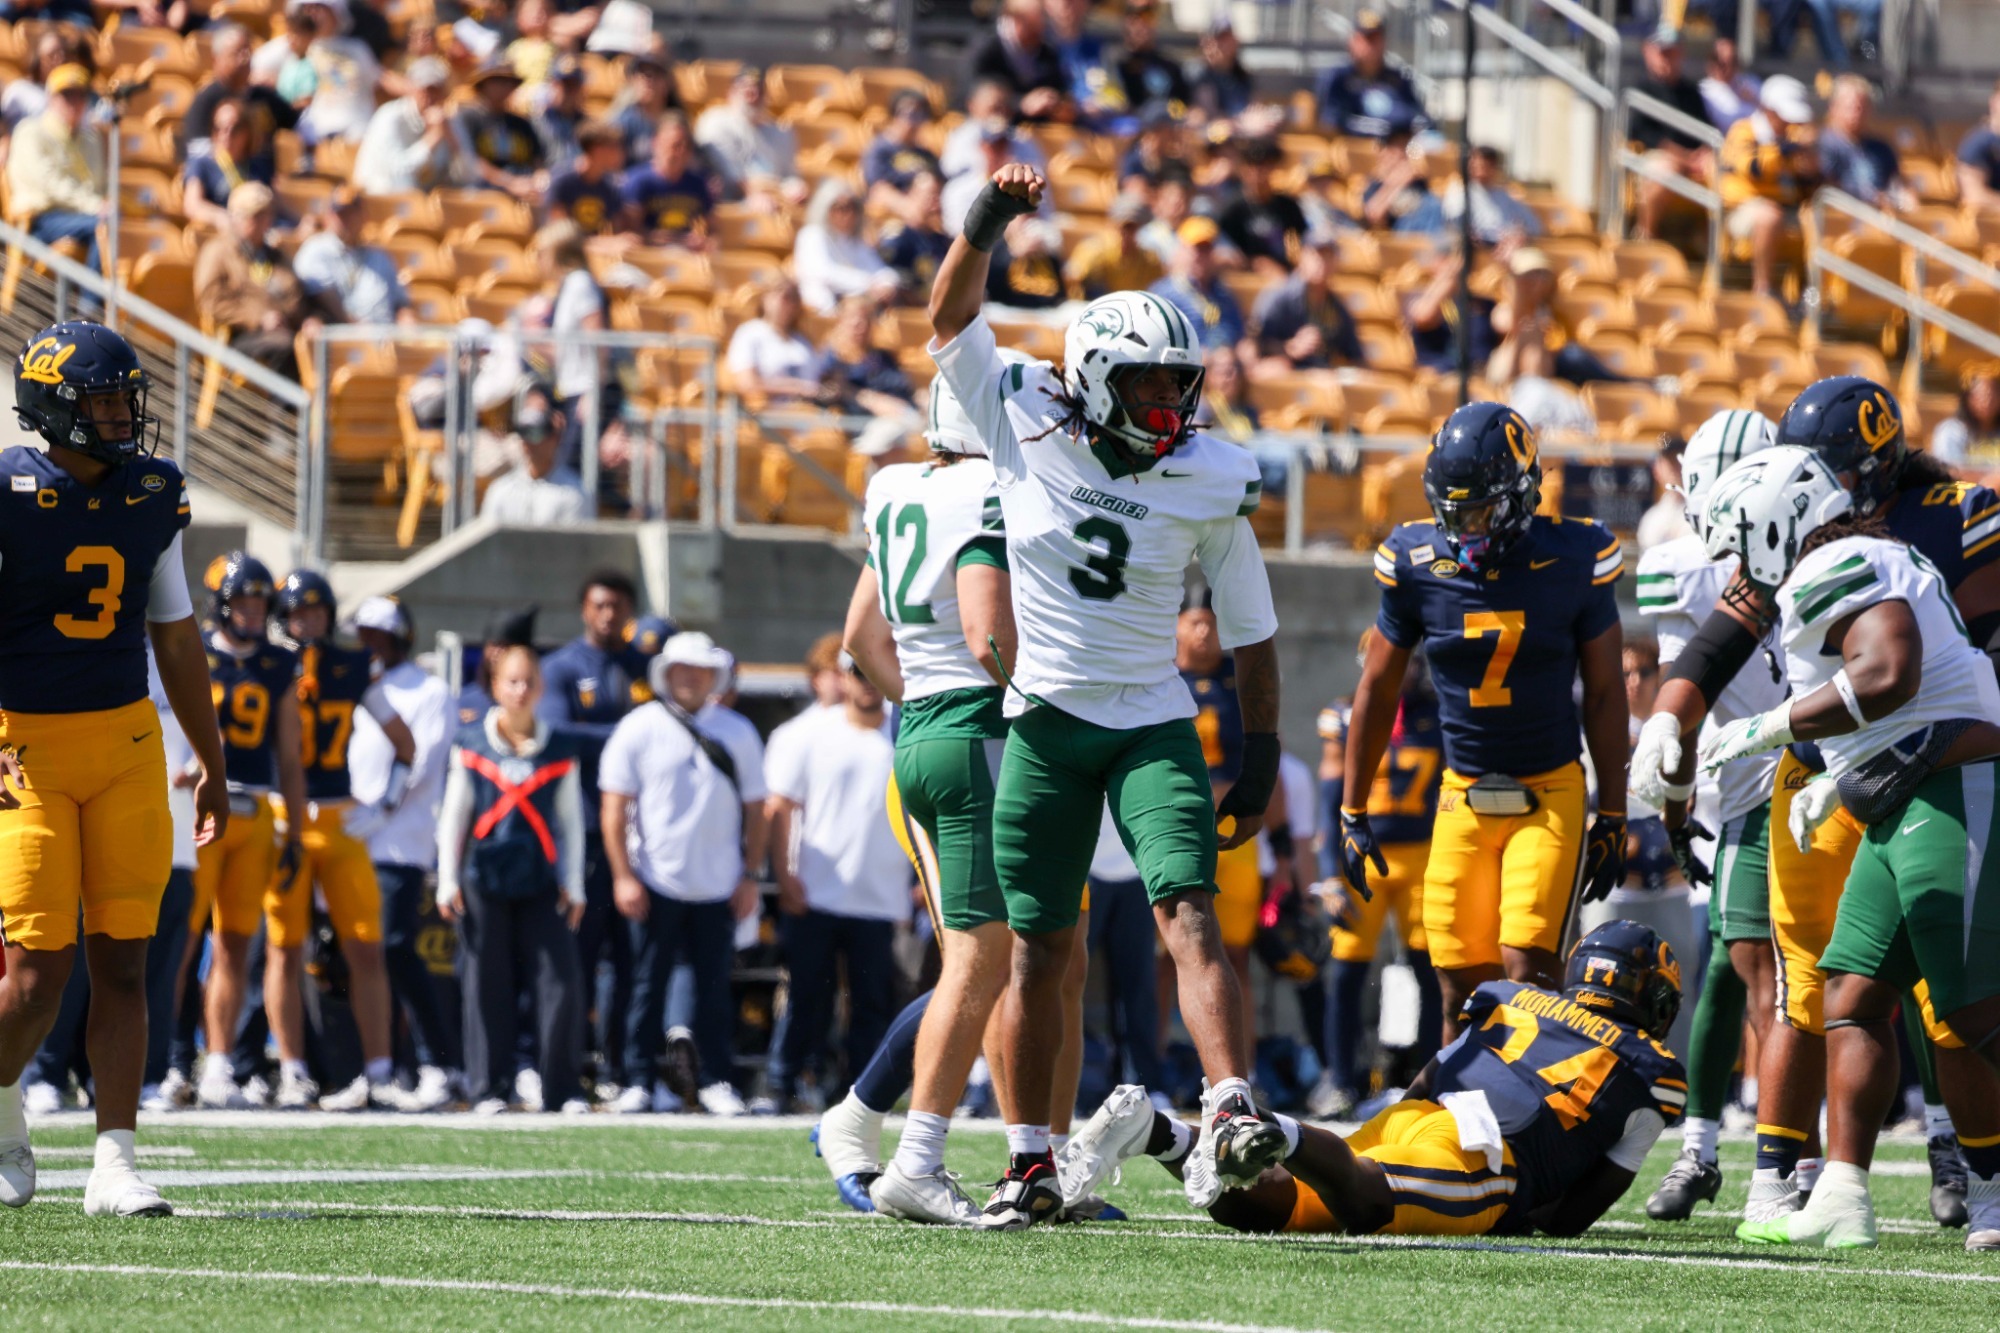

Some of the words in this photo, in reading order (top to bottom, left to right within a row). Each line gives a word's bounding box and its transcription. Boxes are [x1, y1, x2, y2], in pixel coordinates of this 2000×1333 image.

[20, 337, 76, 384] Cal
[1858, 391, 1898, 452] Cal
[37, 488, 58, 508] C
[1070, 485, 1149, 521] WAGNER
[53, 545, 125, 639] 3
[876, 502, 937, 624] 12
[1067, 514, 1133, 603] 3
[1463, 610, 1526, 708] 7
[1509, 988, 1622, 1047] MOHAMMED
[1480, 1003, 1620, 1131] 24
